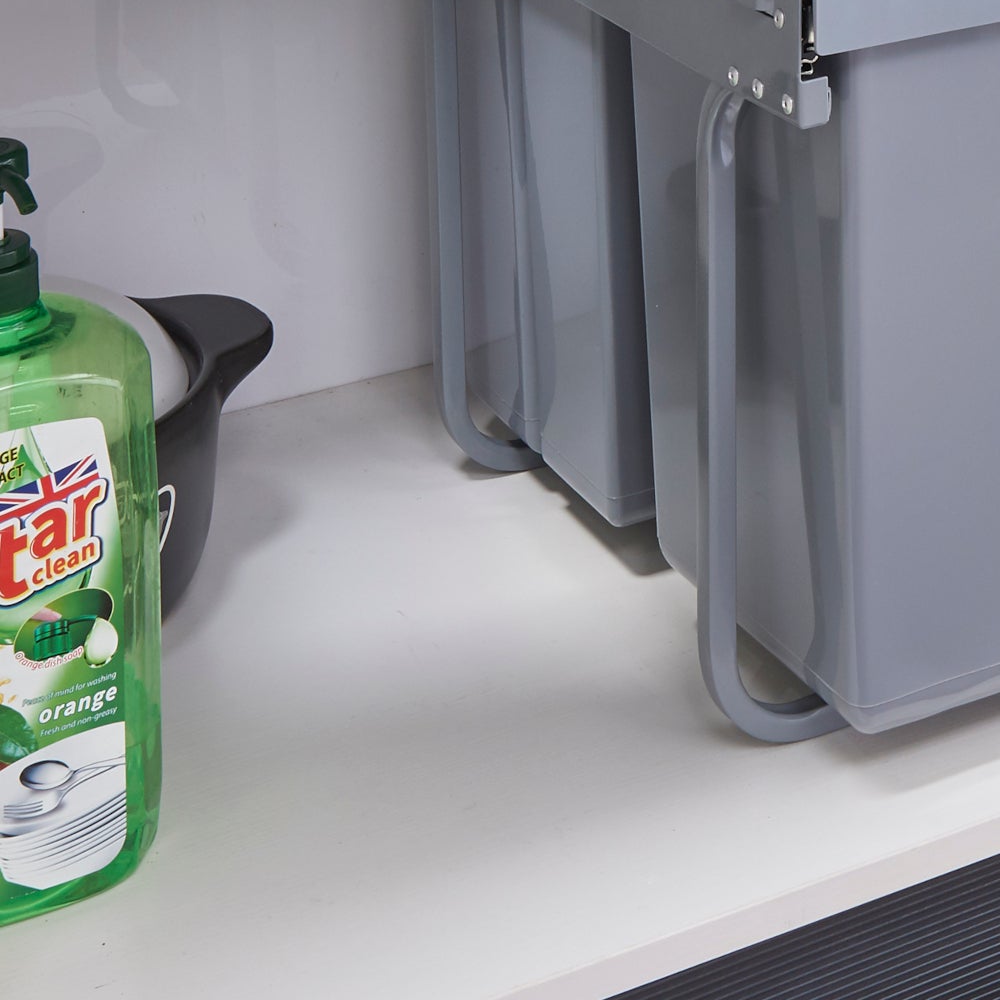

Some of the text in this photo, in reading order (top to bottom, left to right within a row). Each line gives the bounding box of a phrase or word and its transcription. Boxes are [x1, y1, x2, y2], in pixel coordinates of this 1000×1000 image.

[32, 540, 96, 586] clean
[44, 656, 63, 669] dish
[63, 646, 83, 663] soap
[54, 684, 75, 697] mind
[75, 681, 86, 691] for
[86, 671, 117, 688] washing
[38, 686, 118, 724] orange
[40, 706, 118, 737] Fresh and non-greasy
